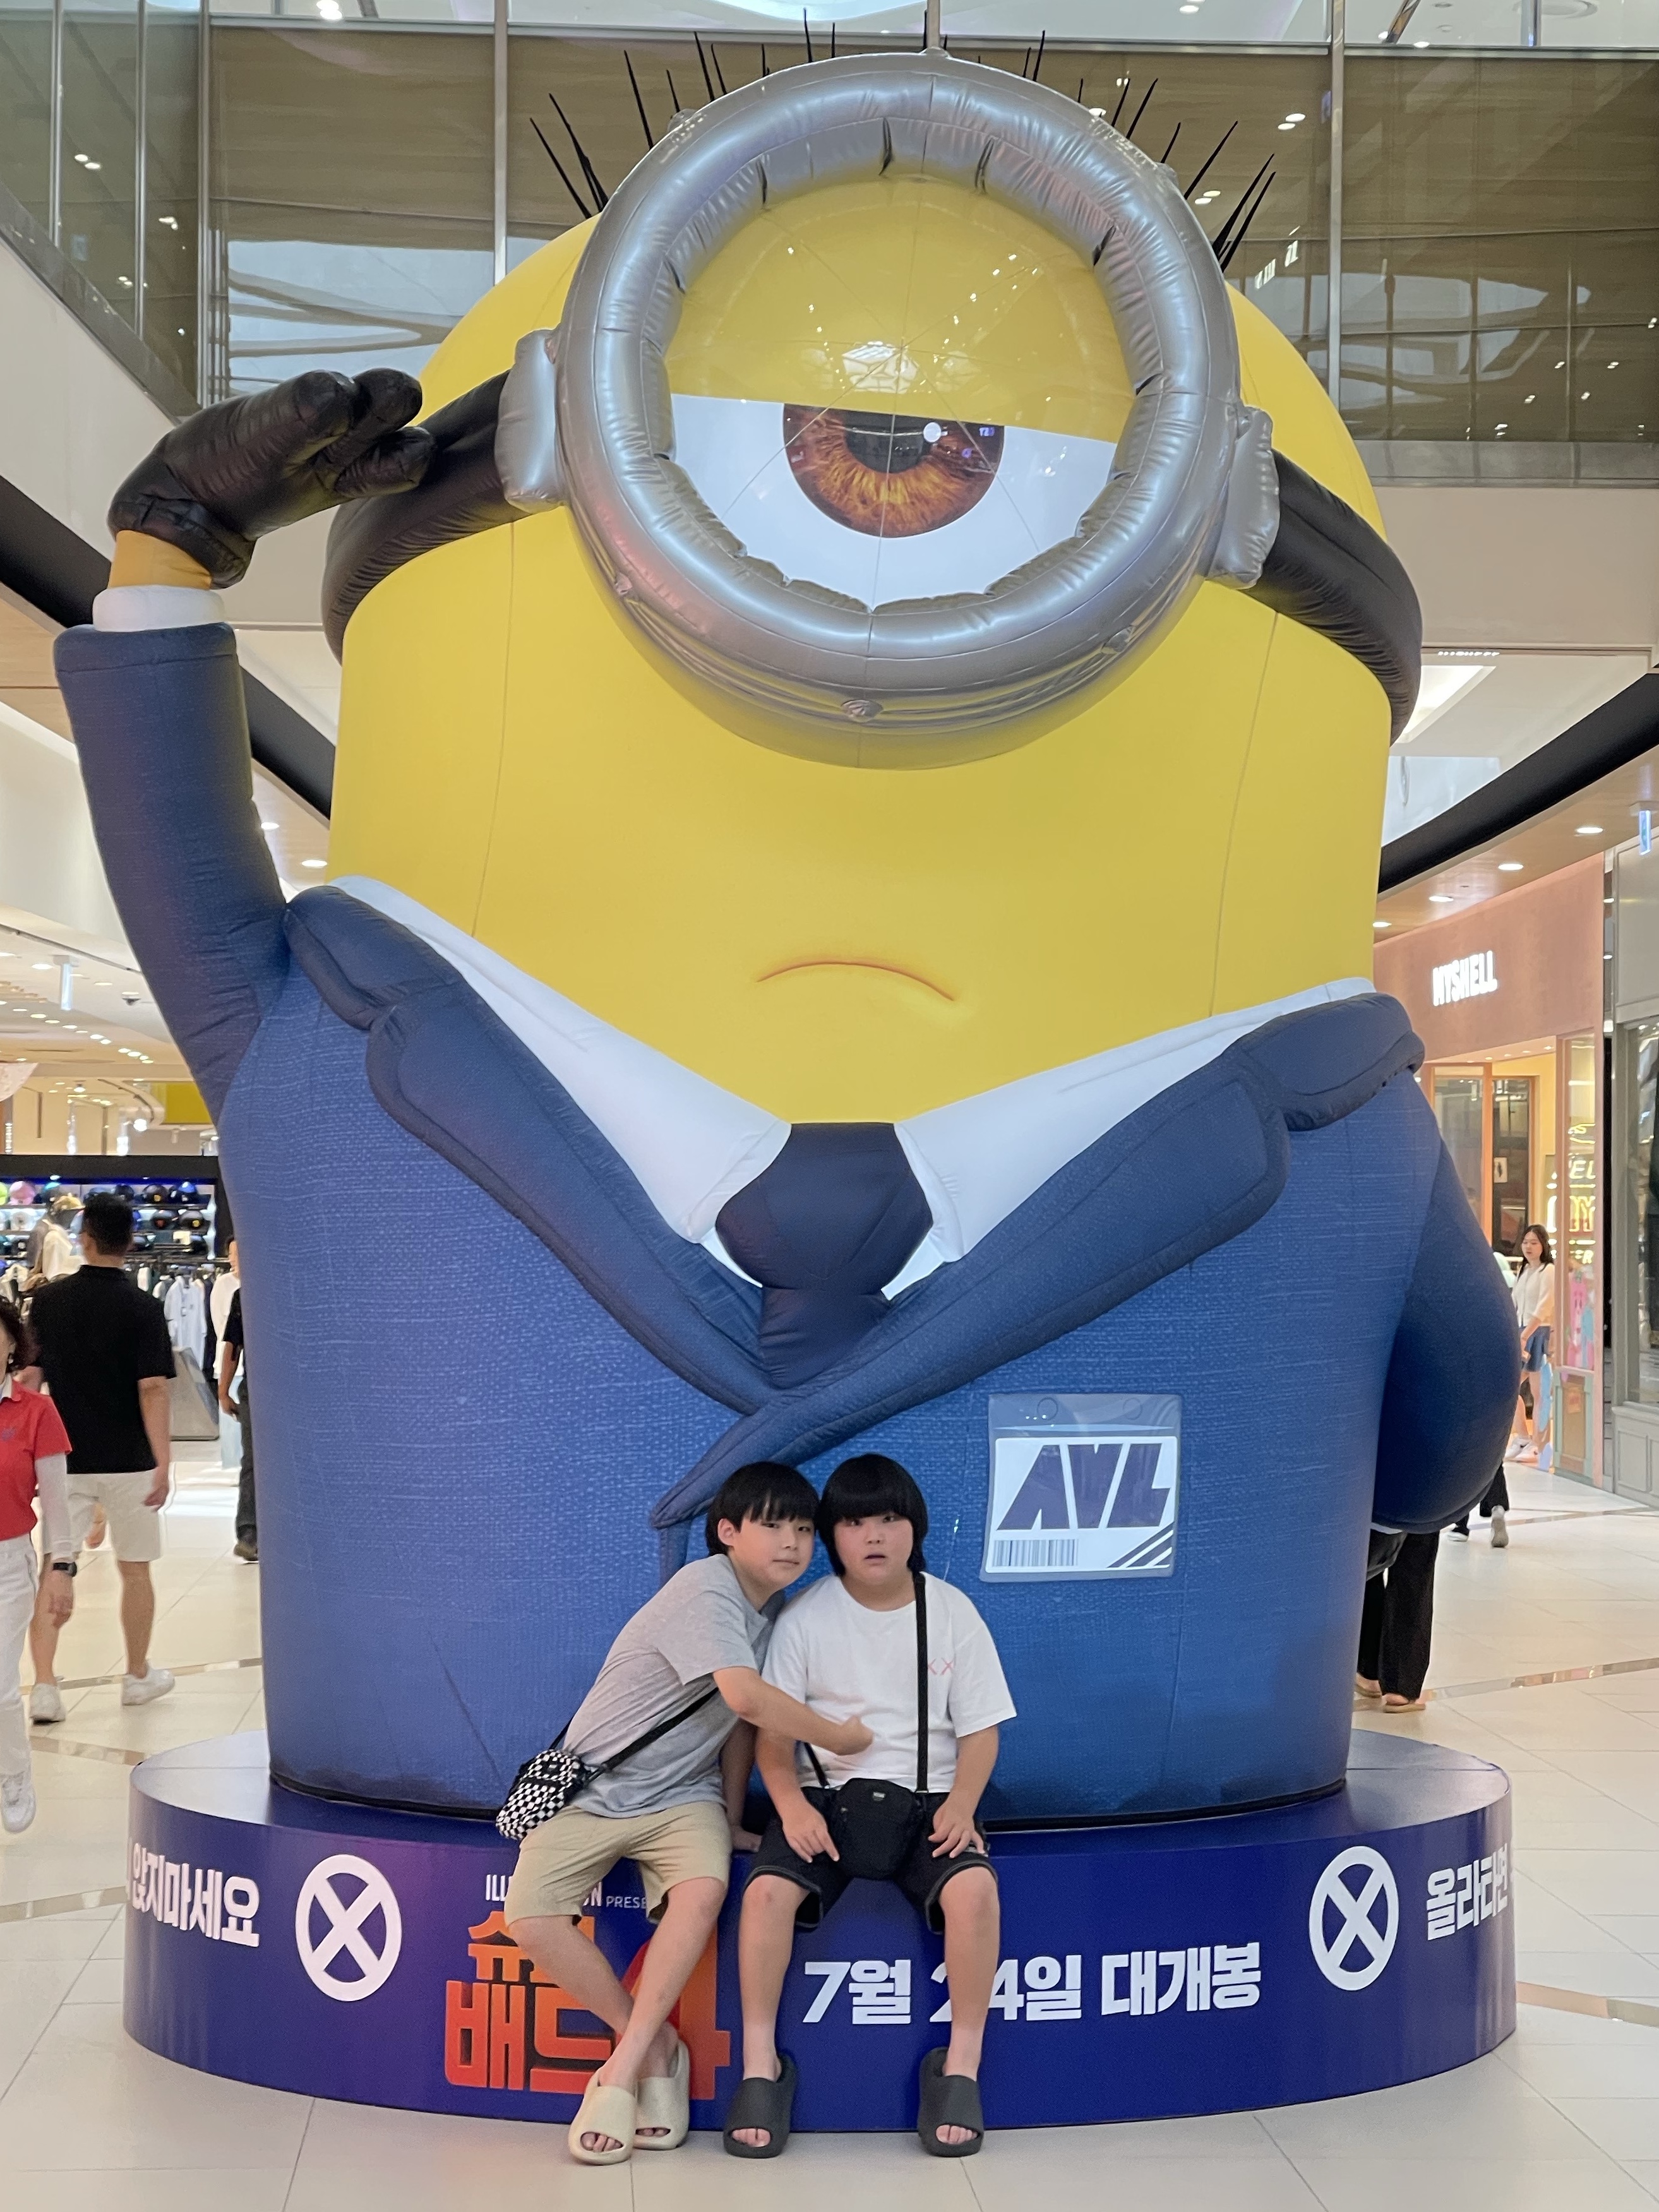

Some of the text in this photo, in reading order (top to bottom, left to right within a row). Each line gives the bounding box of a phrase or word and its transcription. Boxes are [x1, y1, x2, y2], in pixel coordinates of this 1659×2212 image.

[1432, 950, 1498, 1007] MYSHELL
[997, 1443, 1171, 1531] AVL
[132, 1843, 260, 1947] 앉지마세요
[606, 1896, 647, 1909] PRESE
[1427, 1843, 1507, 1940] 올라타면
[802, 1959, 911, 2024] 7월
[1101, 1942, 1262, 2016] 대개봉
